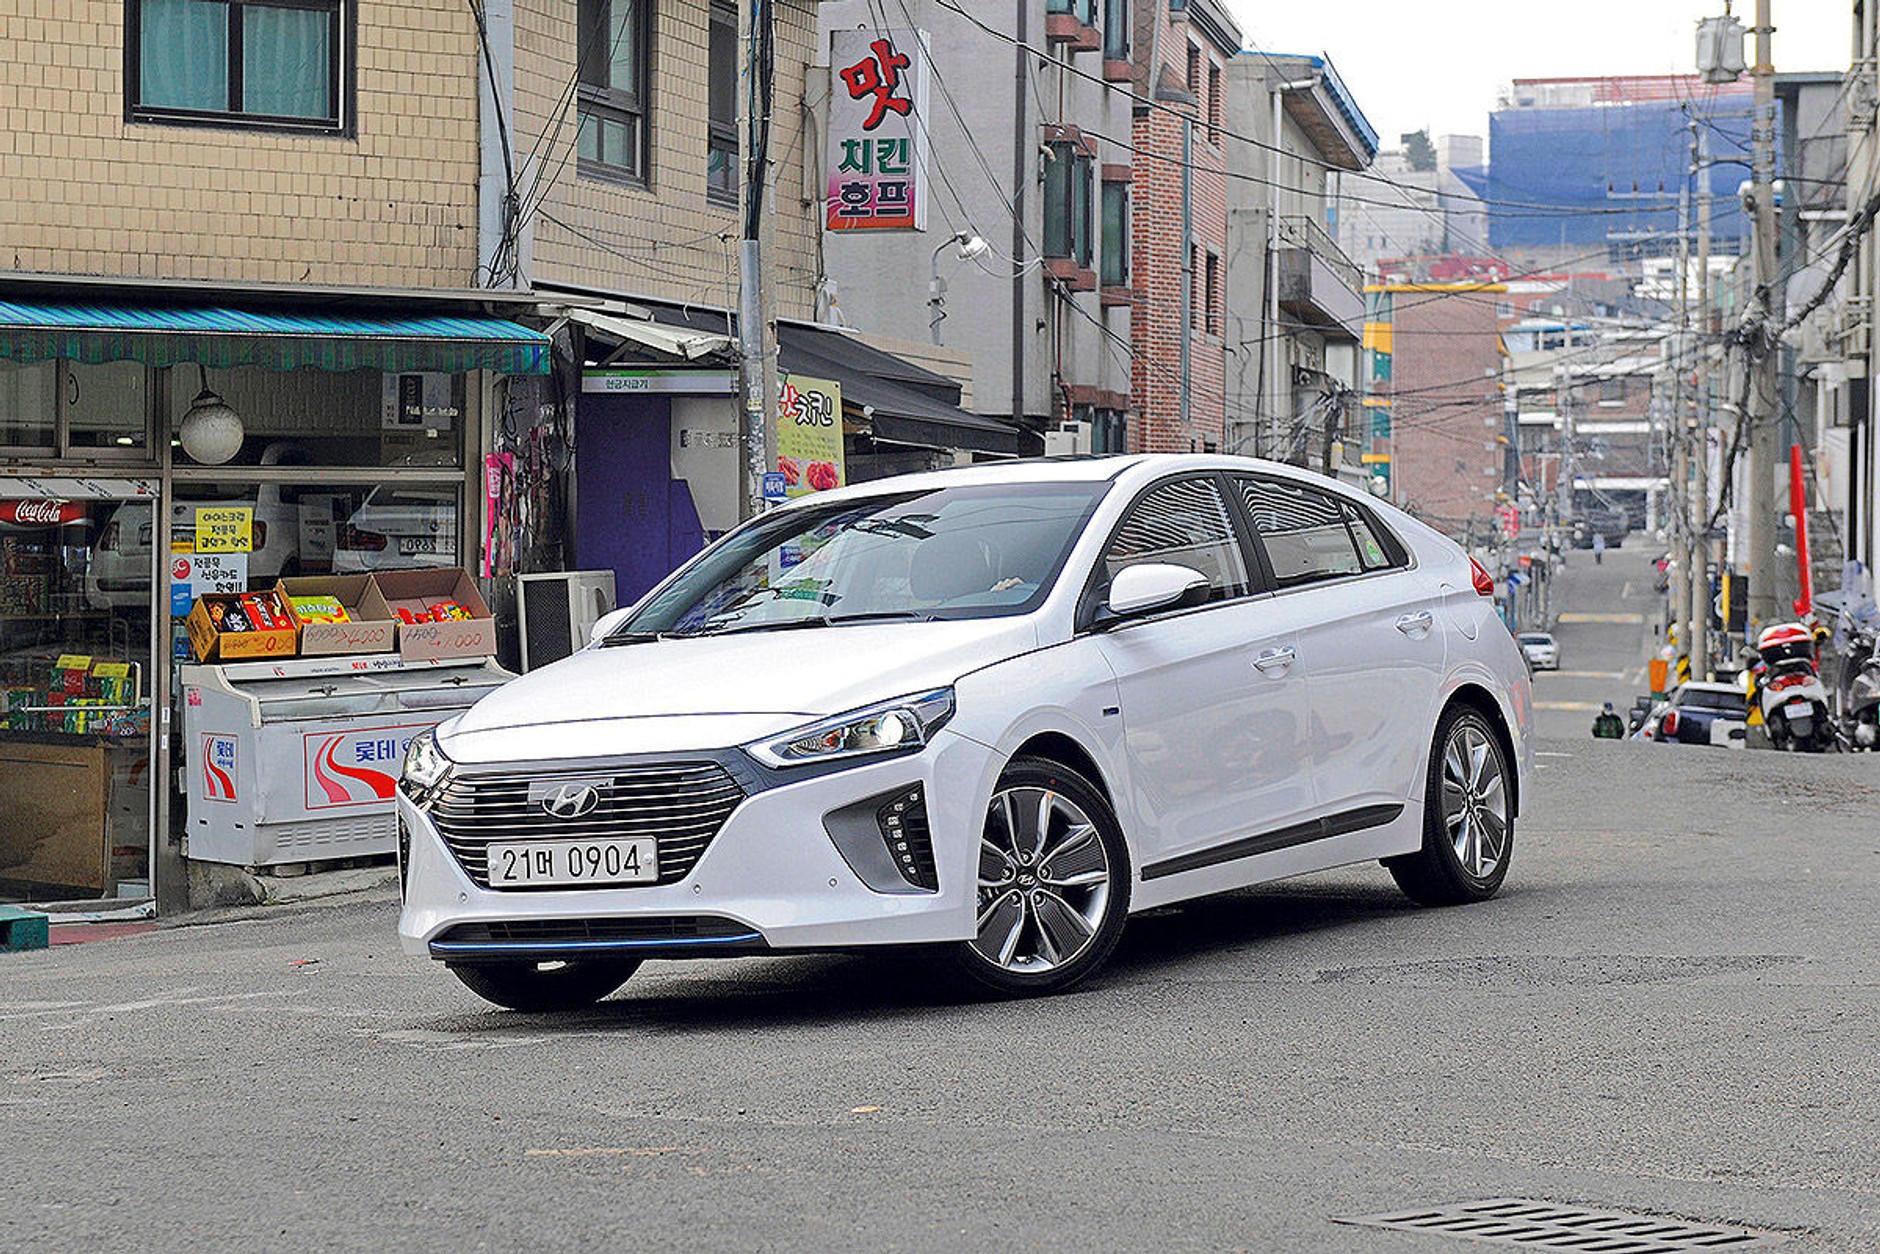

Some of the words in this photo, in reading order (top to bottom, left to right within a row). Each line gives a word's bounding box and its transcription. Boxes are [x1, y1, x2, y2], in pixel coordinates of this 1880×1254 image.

[840, 39, 912, 130] 맛
[838, 138, 909, 176] 치킨
[838, 181, 909, 217] 호프
[355, 739, 397, 762] 롯데
[503, 849, 554, 880] 21머
[567, 844, 641, 878] 0904
